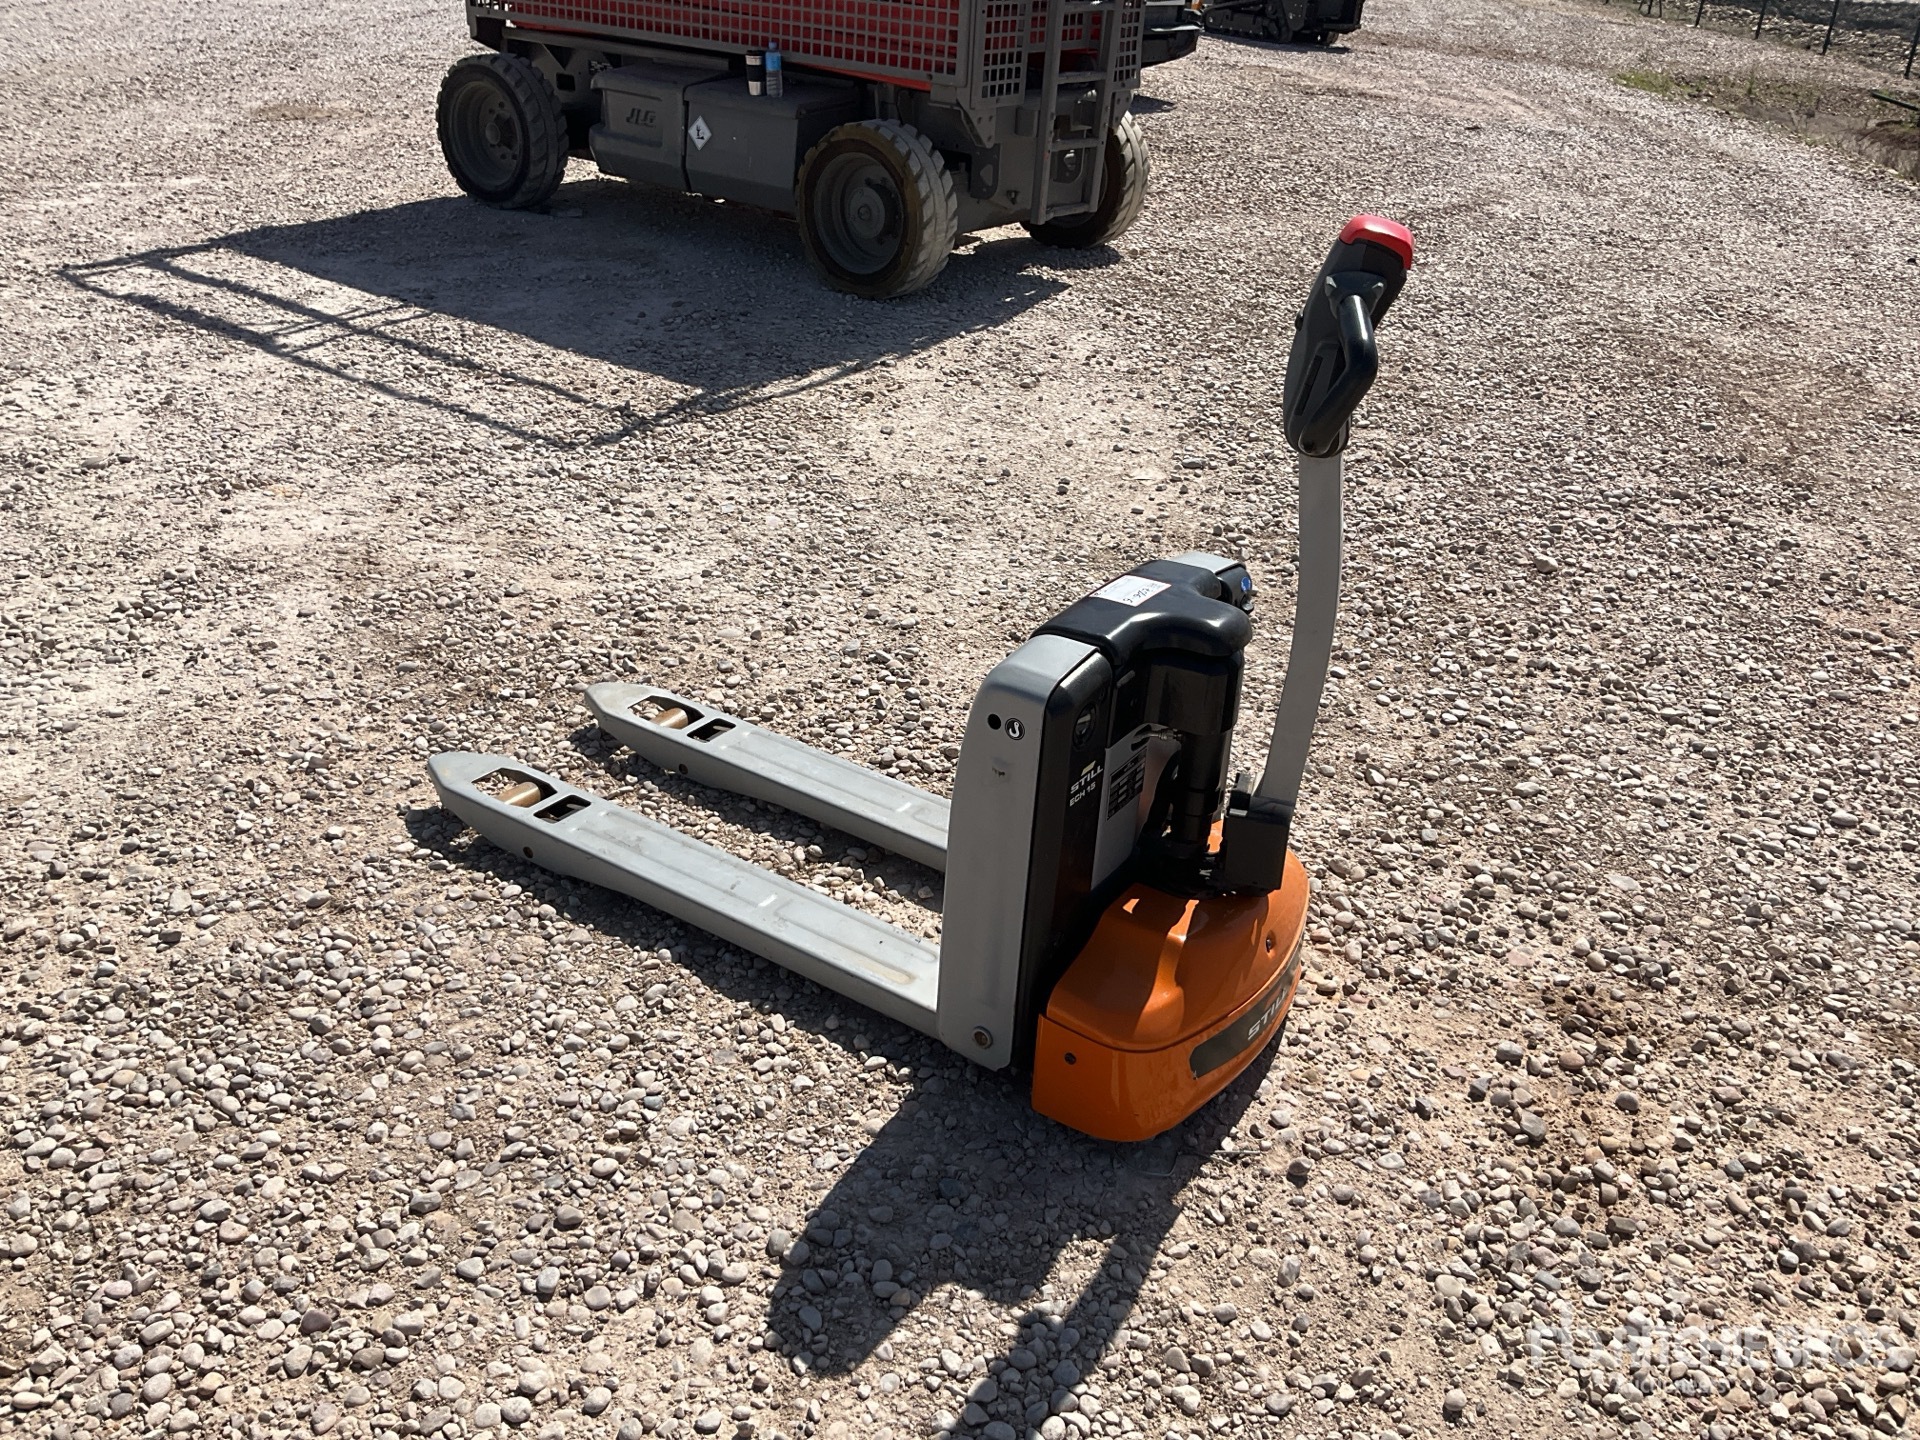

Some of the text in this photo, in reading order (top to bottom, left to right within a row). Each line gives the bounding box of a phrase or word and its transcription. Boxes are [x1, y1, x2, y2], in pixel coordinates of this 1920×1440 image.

[626, 108, 656, 125] JLG
[1070, 765, 1103, 794] STILL
[1069, 781, 1096, 807] ECH 15
[1248, 988, 1288, 1041] STILL
